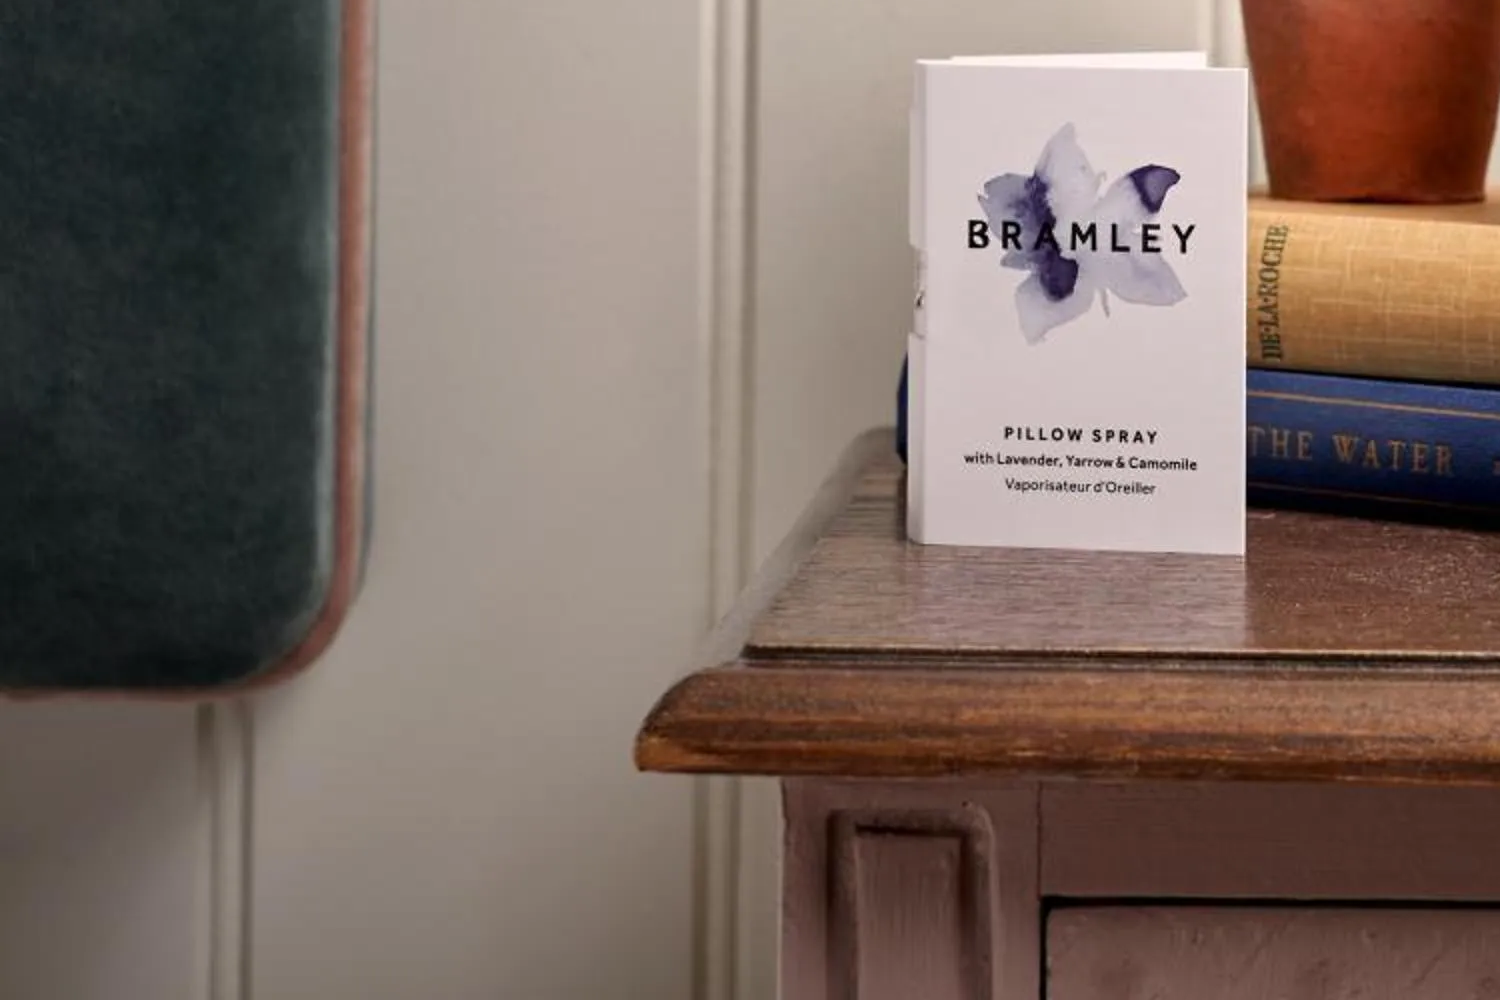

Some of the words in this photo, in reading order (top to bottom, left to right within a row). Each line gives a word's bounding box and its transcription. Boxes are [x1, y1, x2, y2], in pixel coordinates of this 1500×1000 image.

[967, 219, 1197, 255] BRAMLEY
[1003, 426, 1083, 442] PILLOW
[1091, 428, 1158, 444] SPRAY
[963, 451, 994, 465] with
[996, 453, 1063, 468] Lavender,
[1065, 455, 1113, 468] Yarrow
[1115, 456, 1126, 469] &
[1127, 456, 1198, 471] Camomile
[1248, 425, 1314, 462] THE
[1331, 433, 1455, 479] WATER
[1005, 478, 1091, 494] Vaporisateur
